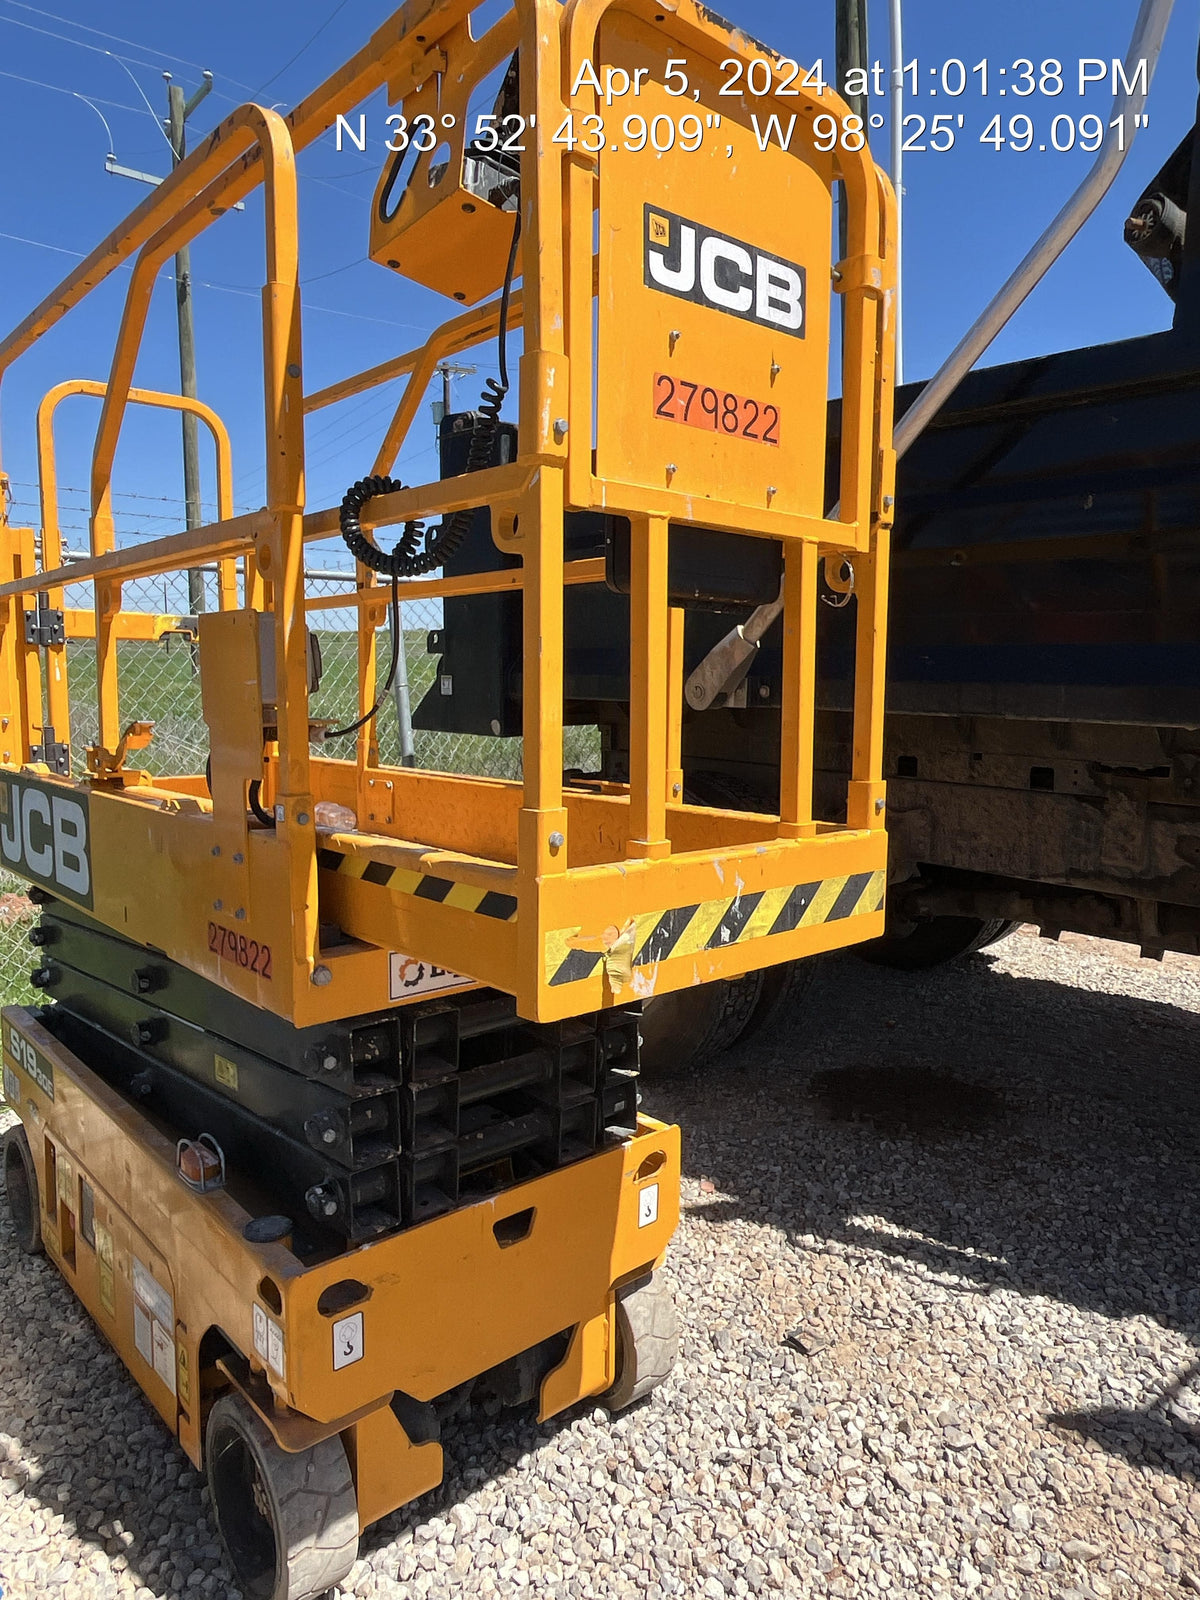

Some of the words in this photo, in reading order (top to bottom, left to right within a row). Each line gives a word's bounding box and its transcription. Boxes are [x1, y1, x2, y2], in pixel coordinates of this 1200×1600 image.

[648, 223, 803, 330] JCB
[655, 374, 779, 444] 279822
[1, 783, 90, 896] JCB
[208, 921, 272, 980] 279822
